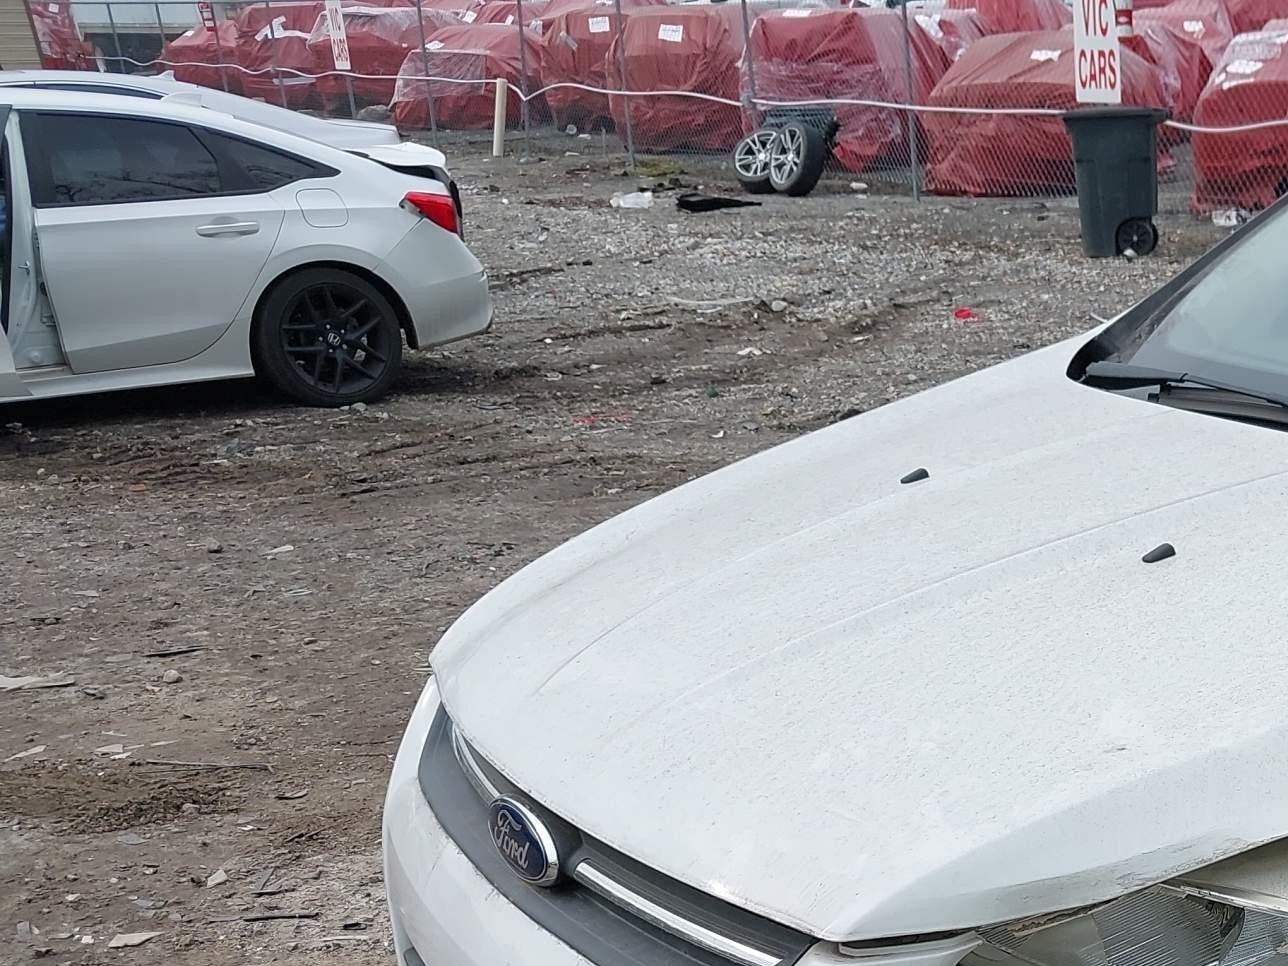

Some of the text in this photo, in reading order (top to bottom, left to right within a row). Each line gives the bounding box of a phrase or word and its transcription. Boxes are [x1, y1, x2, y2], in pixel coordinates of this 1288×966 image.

[1081, 0, 1109, 37] VIC
[1078, 48, 1117, 90] CARS
[493, 809, 530, 869] Ford
